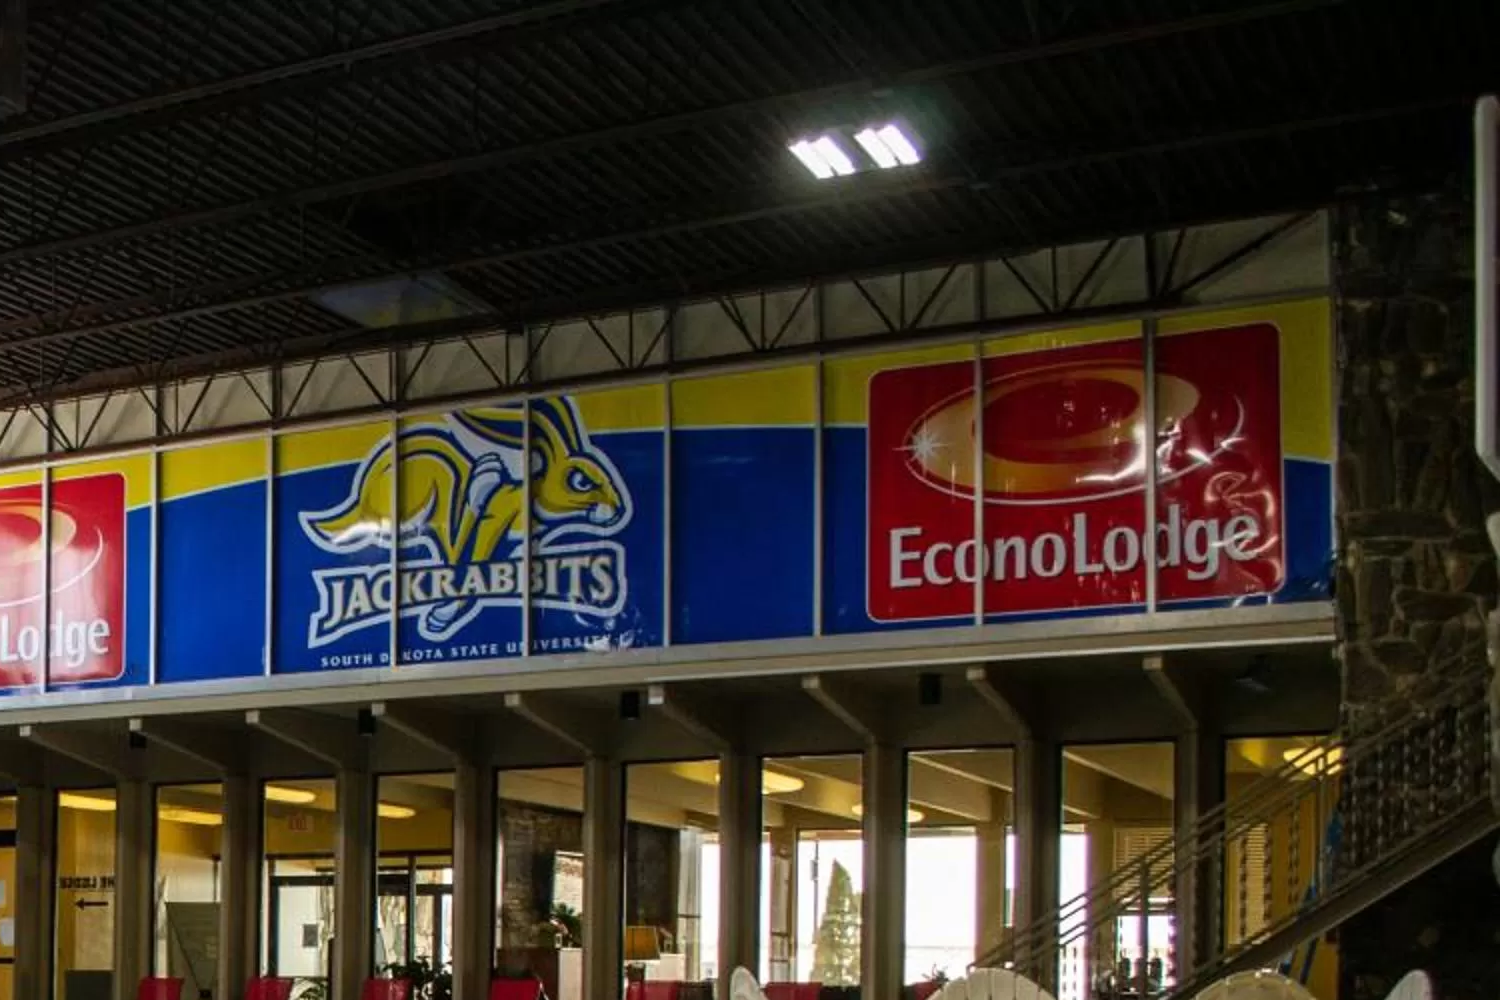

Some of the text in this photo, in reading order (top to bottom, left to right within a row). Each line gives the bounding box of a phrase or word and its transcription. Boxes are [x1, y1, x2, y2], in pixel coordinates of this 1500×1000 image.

[889, 504, 1260, 589] EconoLodge
[324, 554, 615, 629] JACKRABBITS
[320, 633, 611, 668] SOUTH DKOTA STATE UIVERSITY
